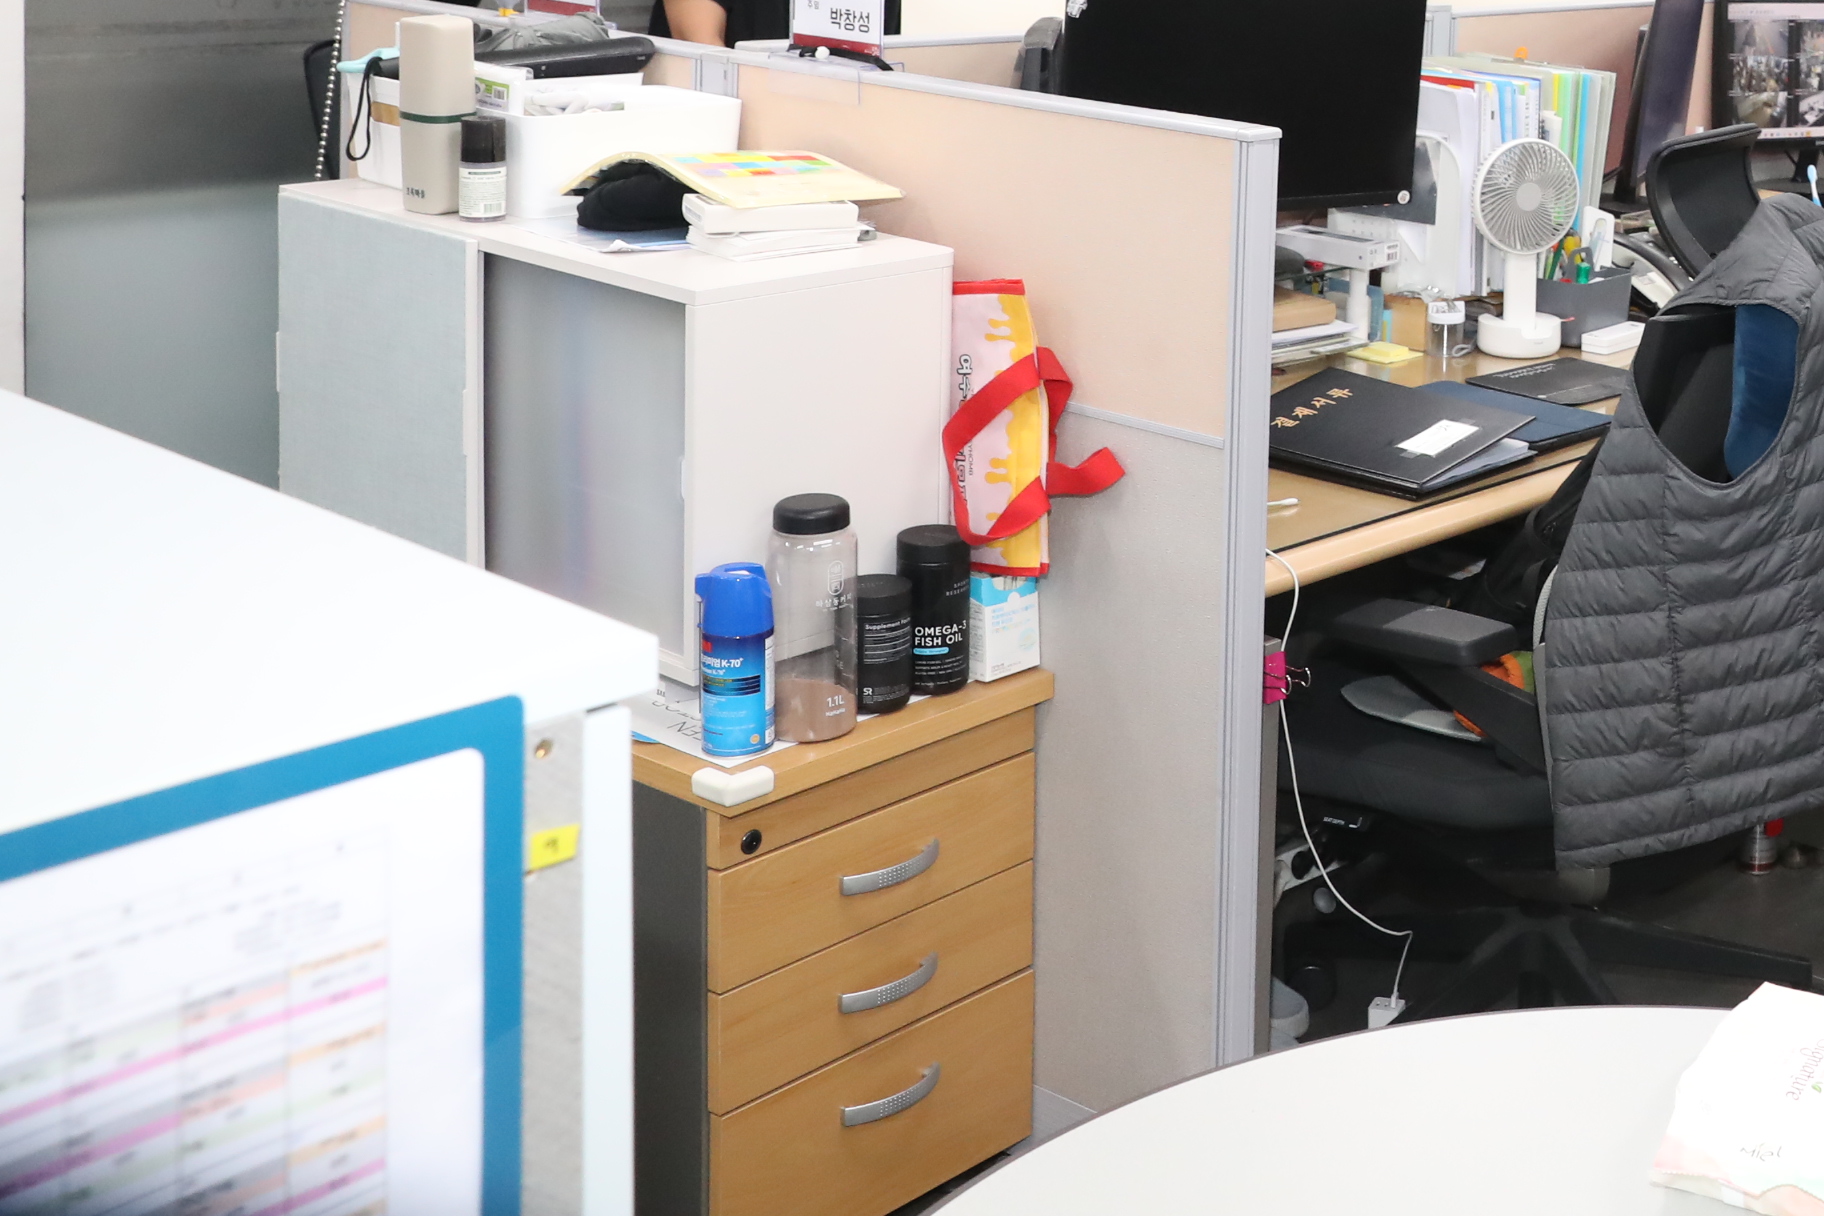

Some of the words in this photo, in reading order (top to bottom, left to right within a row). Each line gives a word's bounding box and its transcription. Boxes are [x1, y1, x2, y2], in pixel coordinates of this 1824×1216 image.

[830, 7, 870, 33] 박창성
[1270, 387, 1354, 429] 결재서류
[914, 619, 967, 637] OMEGA-3
[914, 636, 942, 647] FISH
[945, 632, 963, 645] OIL
[826, 695, 845, 708] 1.1L
